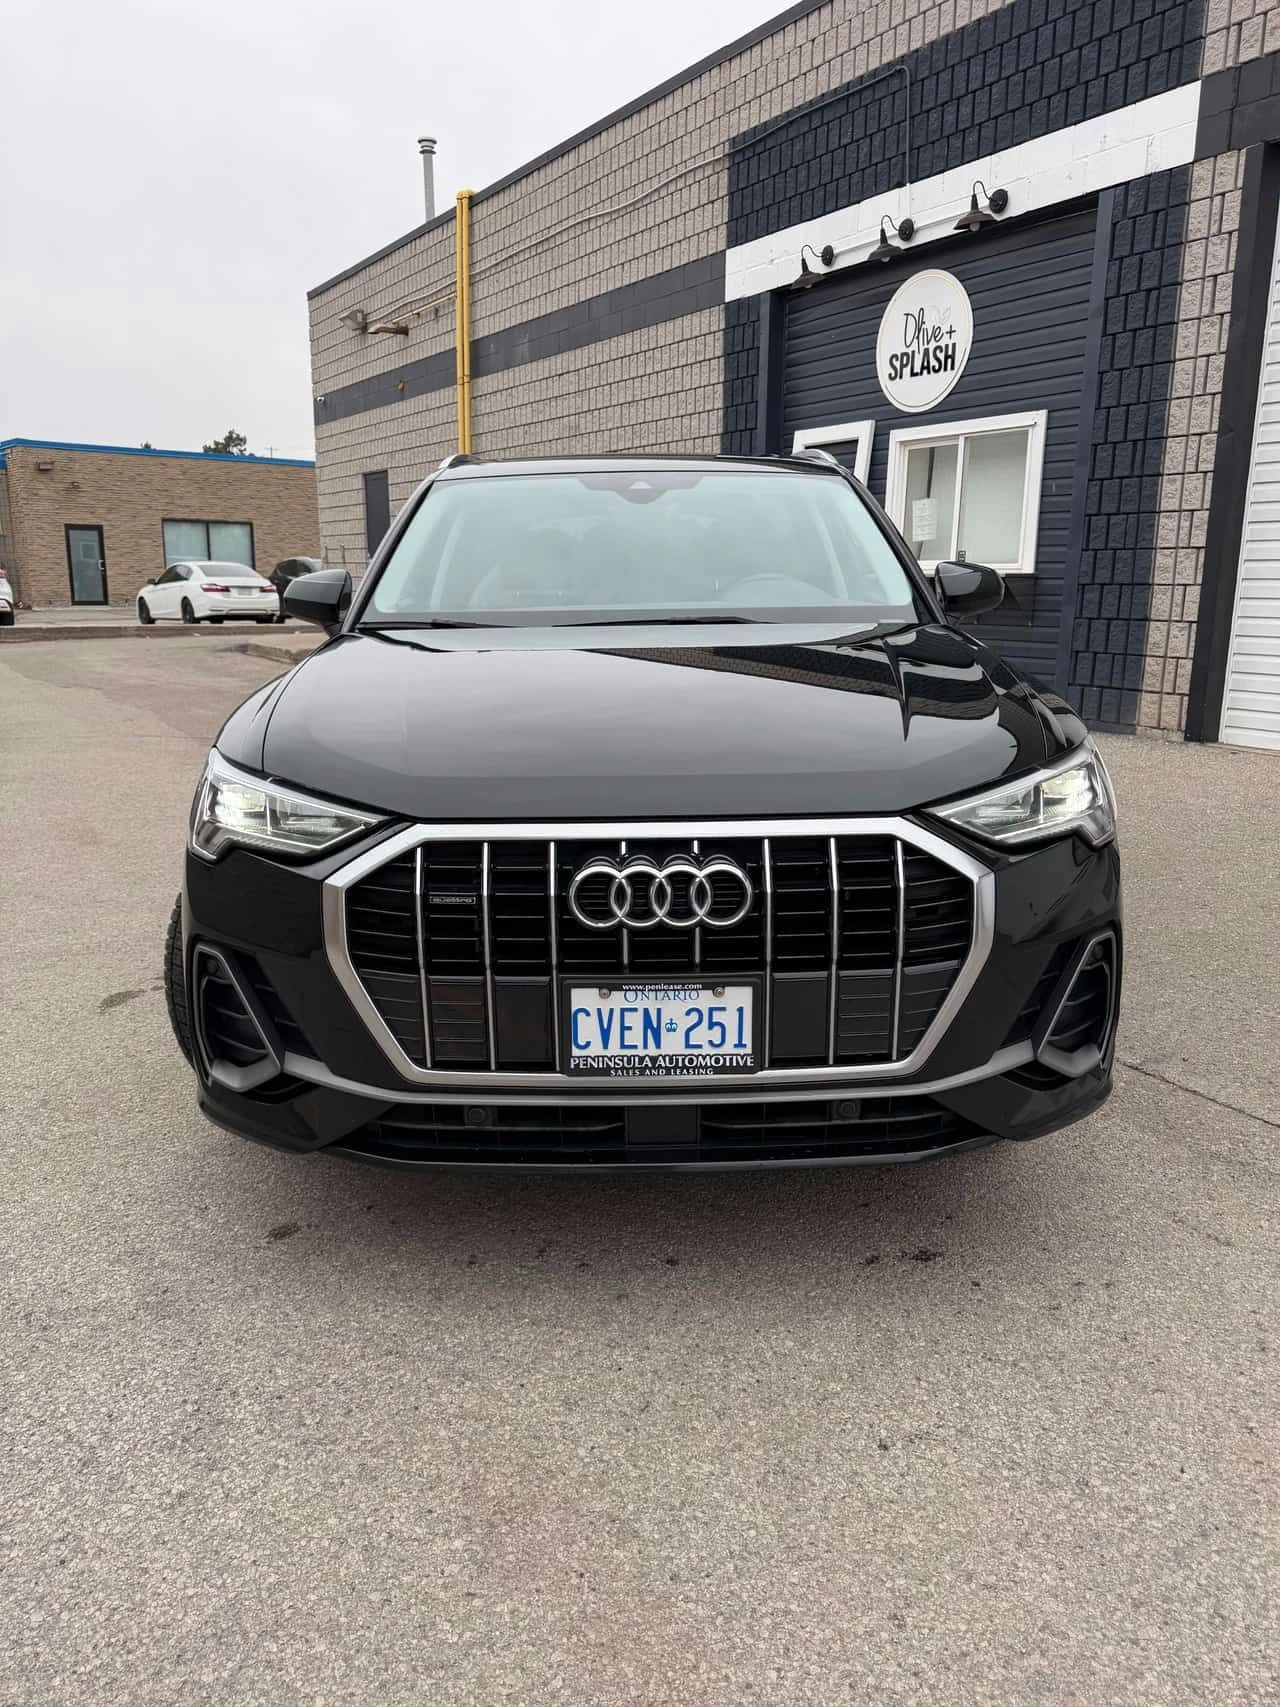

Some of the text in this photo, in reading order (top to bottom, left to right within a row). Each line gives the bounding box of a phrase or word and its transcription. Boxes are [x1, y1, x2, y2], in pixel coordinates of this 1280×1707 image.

[887, 342, 957, 381] SPLASH
[622, 983, 702, 991] www.penlease.com
[572, 1006, 748, 1050] CVEN 251
[570, 1055, 754, 1069] PENINSULA AUTOMOTIVE
[671, 1068, 714, 1076] LEASING
